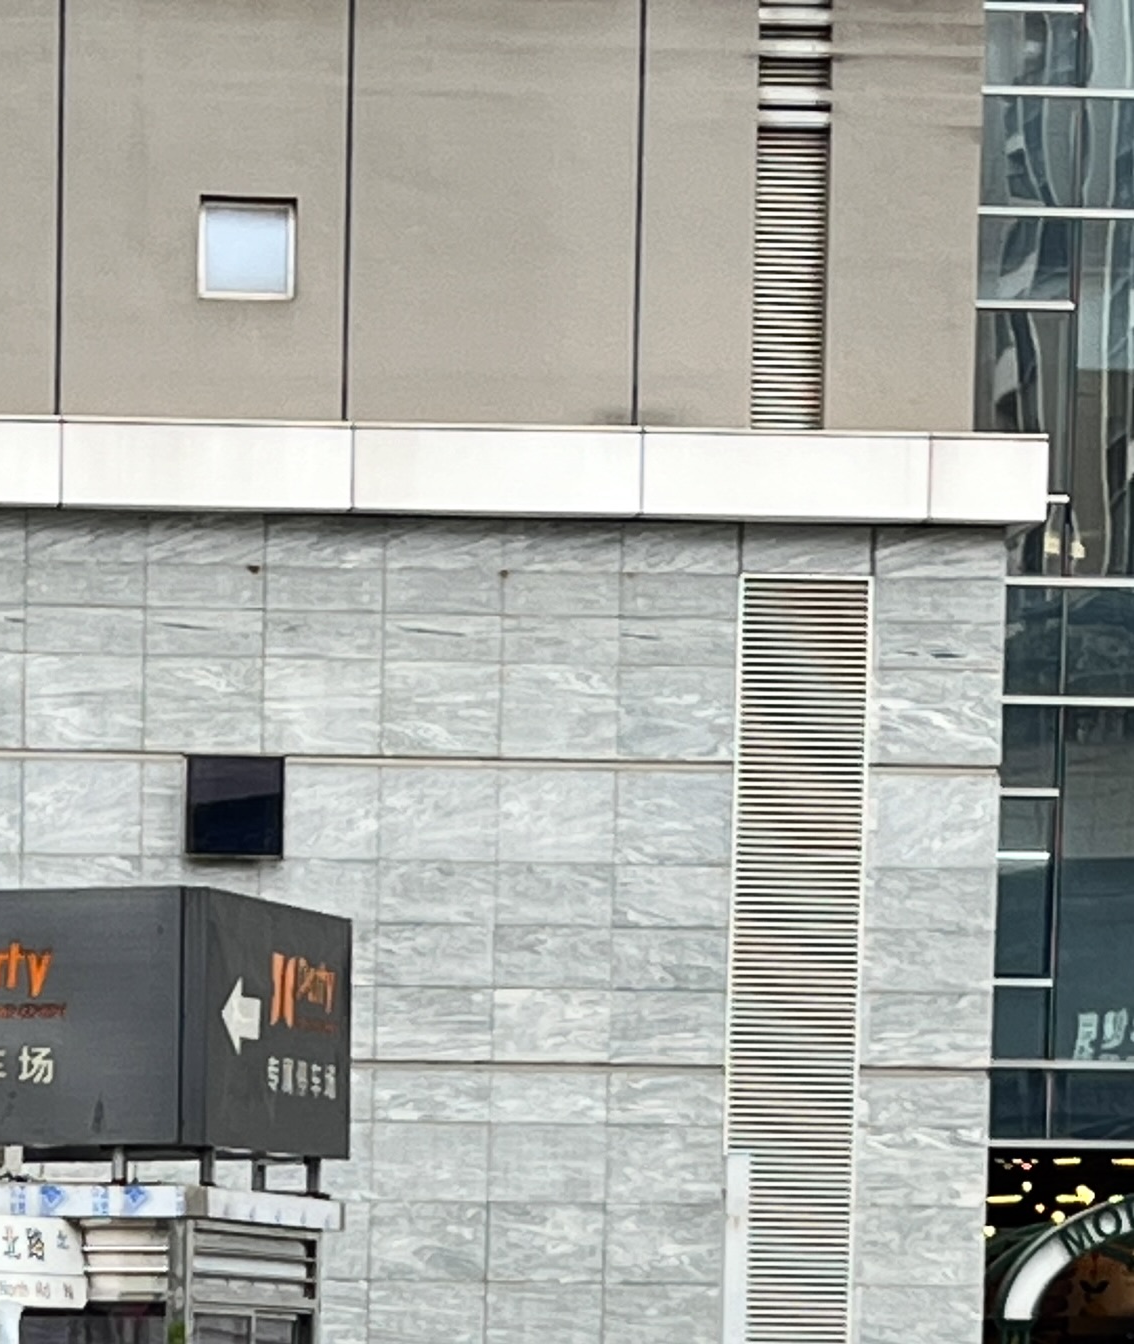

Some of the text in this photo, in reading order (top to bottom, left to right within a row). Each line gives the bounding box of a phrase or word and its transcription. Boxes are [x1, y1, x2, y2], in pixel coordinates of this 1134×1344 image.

[268, 1056, 336, 1100] 专属停车场
